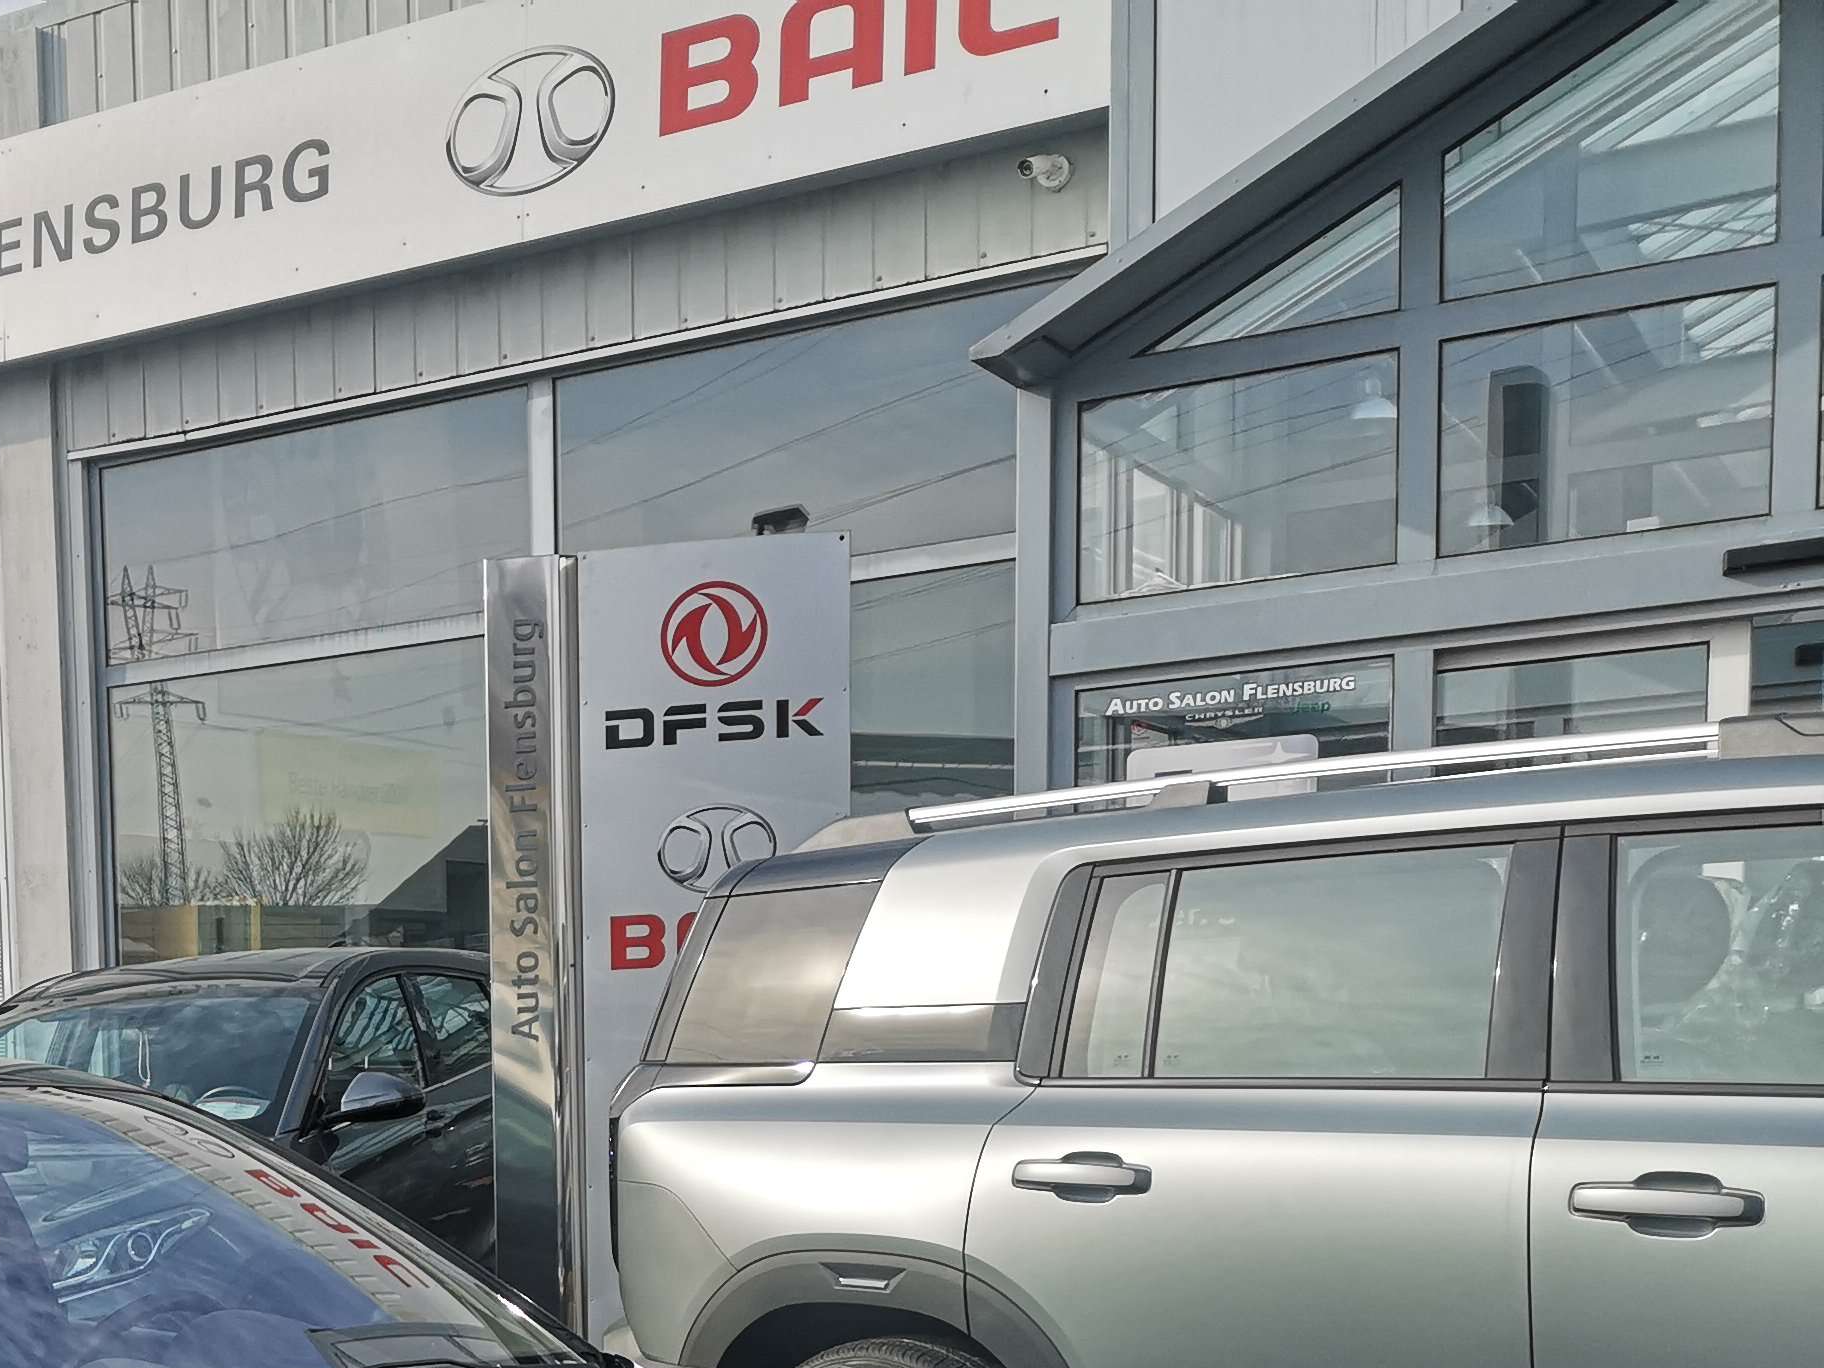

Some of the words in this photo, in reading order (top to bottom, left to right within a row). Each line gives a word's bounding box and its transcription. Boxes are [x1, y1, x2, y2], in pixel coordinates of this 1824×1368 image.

[504, 618, 544, 813] Flensburg
[605, 697, 824, 750] DFSK
[1185, 706, 1264, 720] CHRYSLER
[506, 830, 539, 936] Salon
[610, 912, 697, 970] B
[511, 950, 540, 1041] Auto
